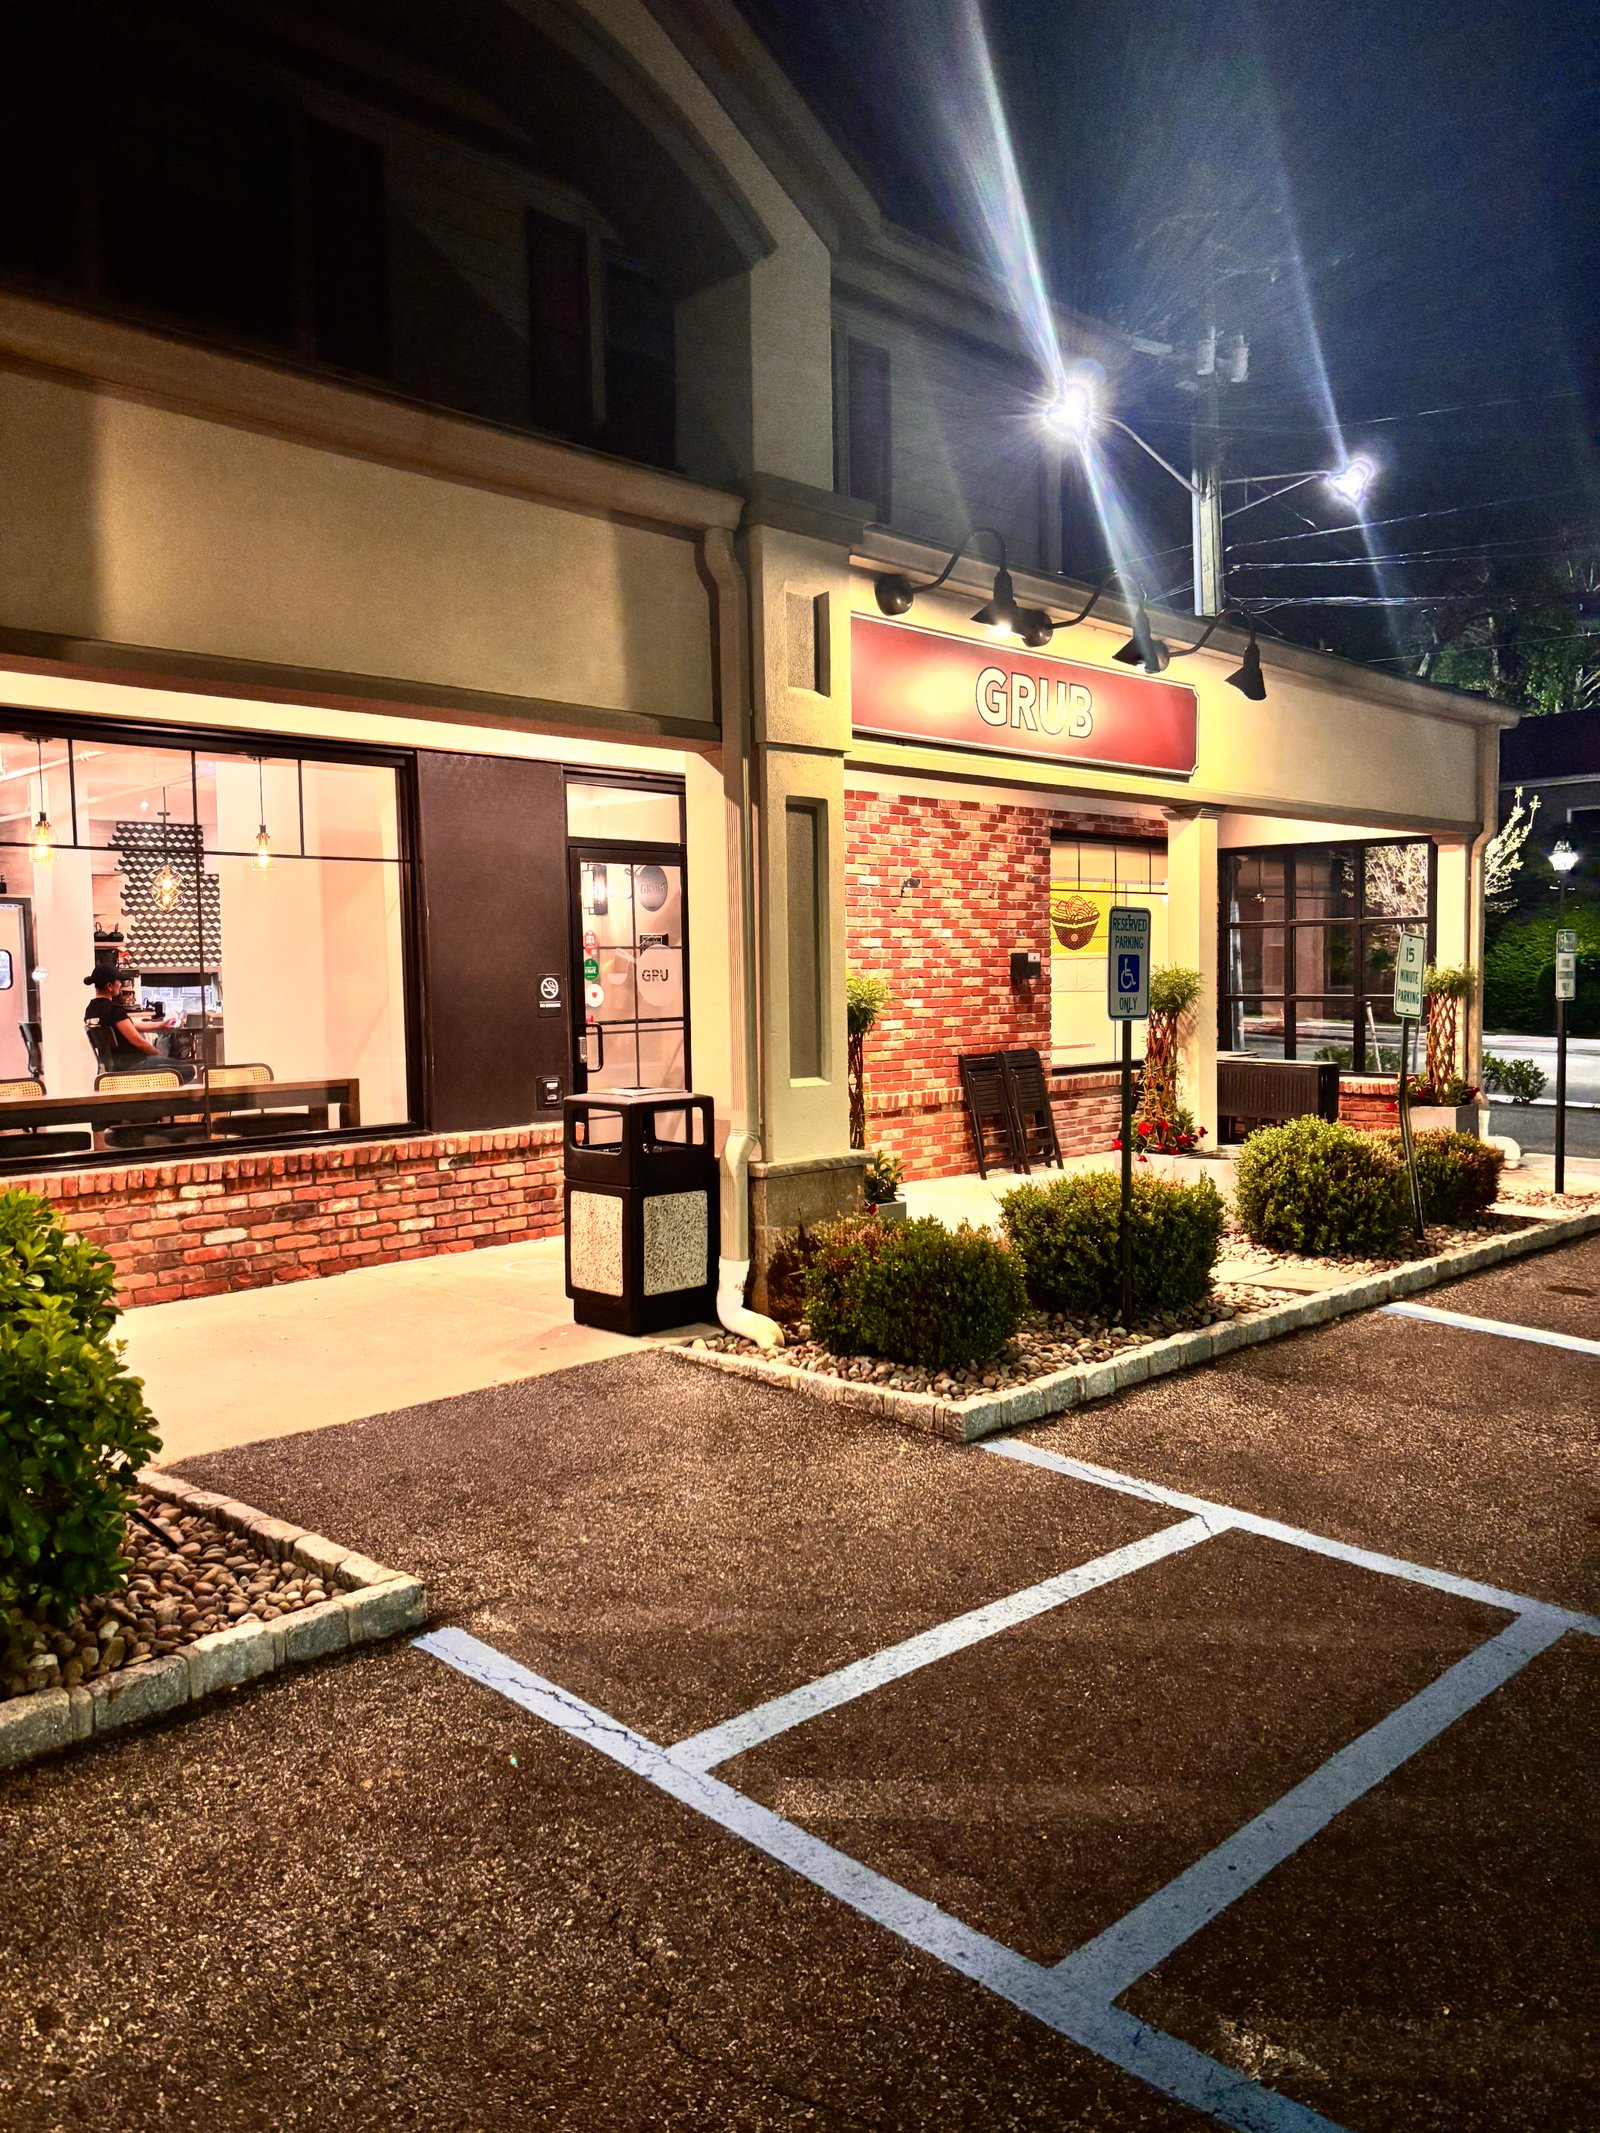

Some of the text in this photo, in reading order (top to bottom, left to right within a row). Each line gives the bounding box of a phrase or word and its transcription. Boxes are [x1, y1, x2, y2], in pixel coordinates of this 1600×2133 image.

[975, 666, 1093, 738] GRUB
[1112, 918, 1147, 932] RESERVED
[1115, 936, 1144, 949] PARKING
[1406, 947, 1415, 962] 15
[1400, 969, 1419, 984] MINUTE
[1119, 997, 1138, 1011] ONLY
[1398, 989, 1419, 1004] PARKING
